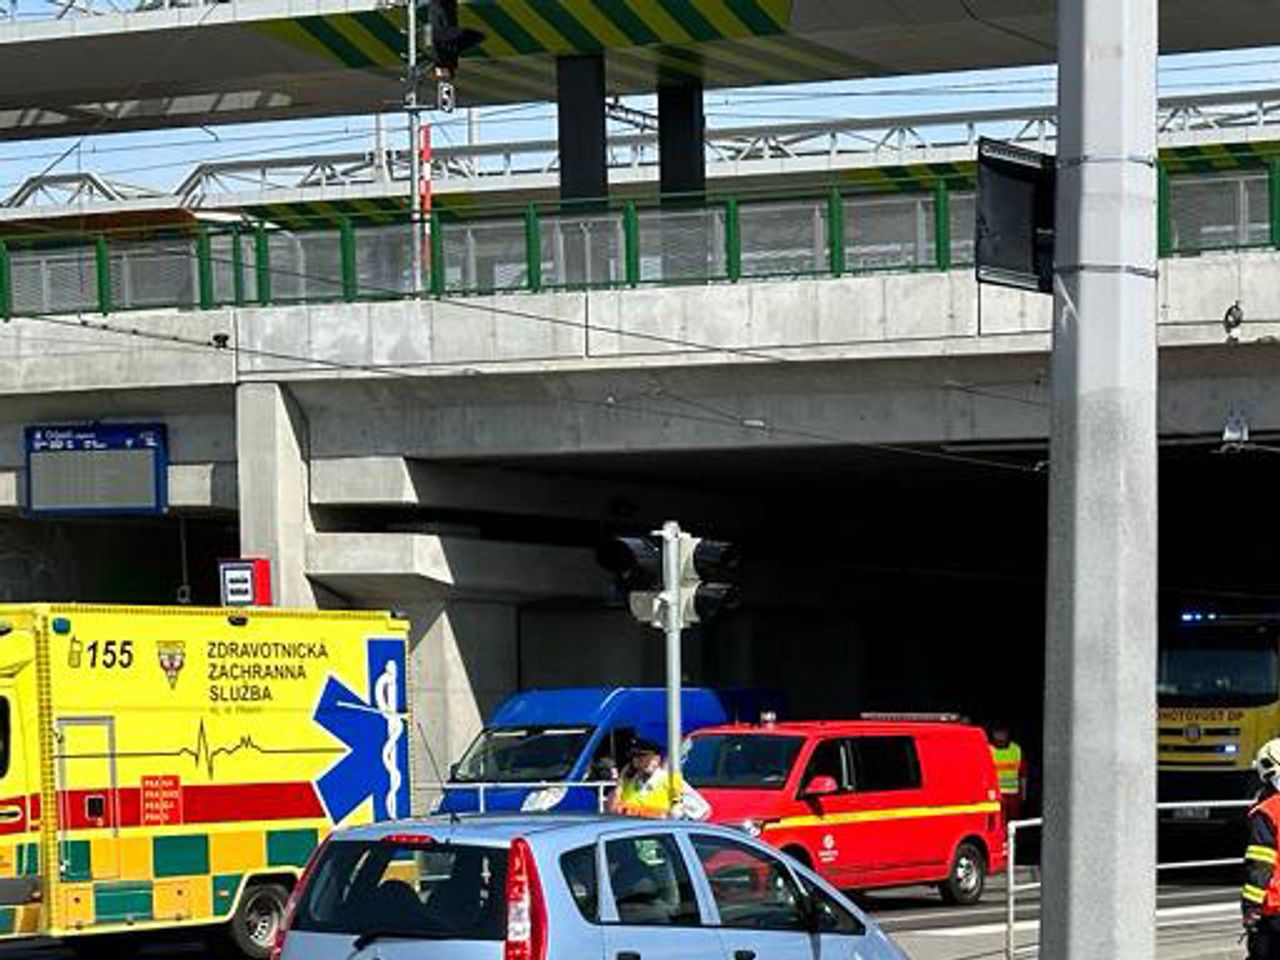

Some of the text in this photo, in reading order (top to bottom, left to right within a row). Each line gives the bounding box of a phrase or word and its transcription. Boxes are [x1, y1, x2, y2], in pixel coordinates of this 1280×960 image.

[87, 640, 133, 668] 155
[207, 638, 328, 659] ZDRAVOTNICKÁ
[208, 681, 273, 701] SLUŽBA
